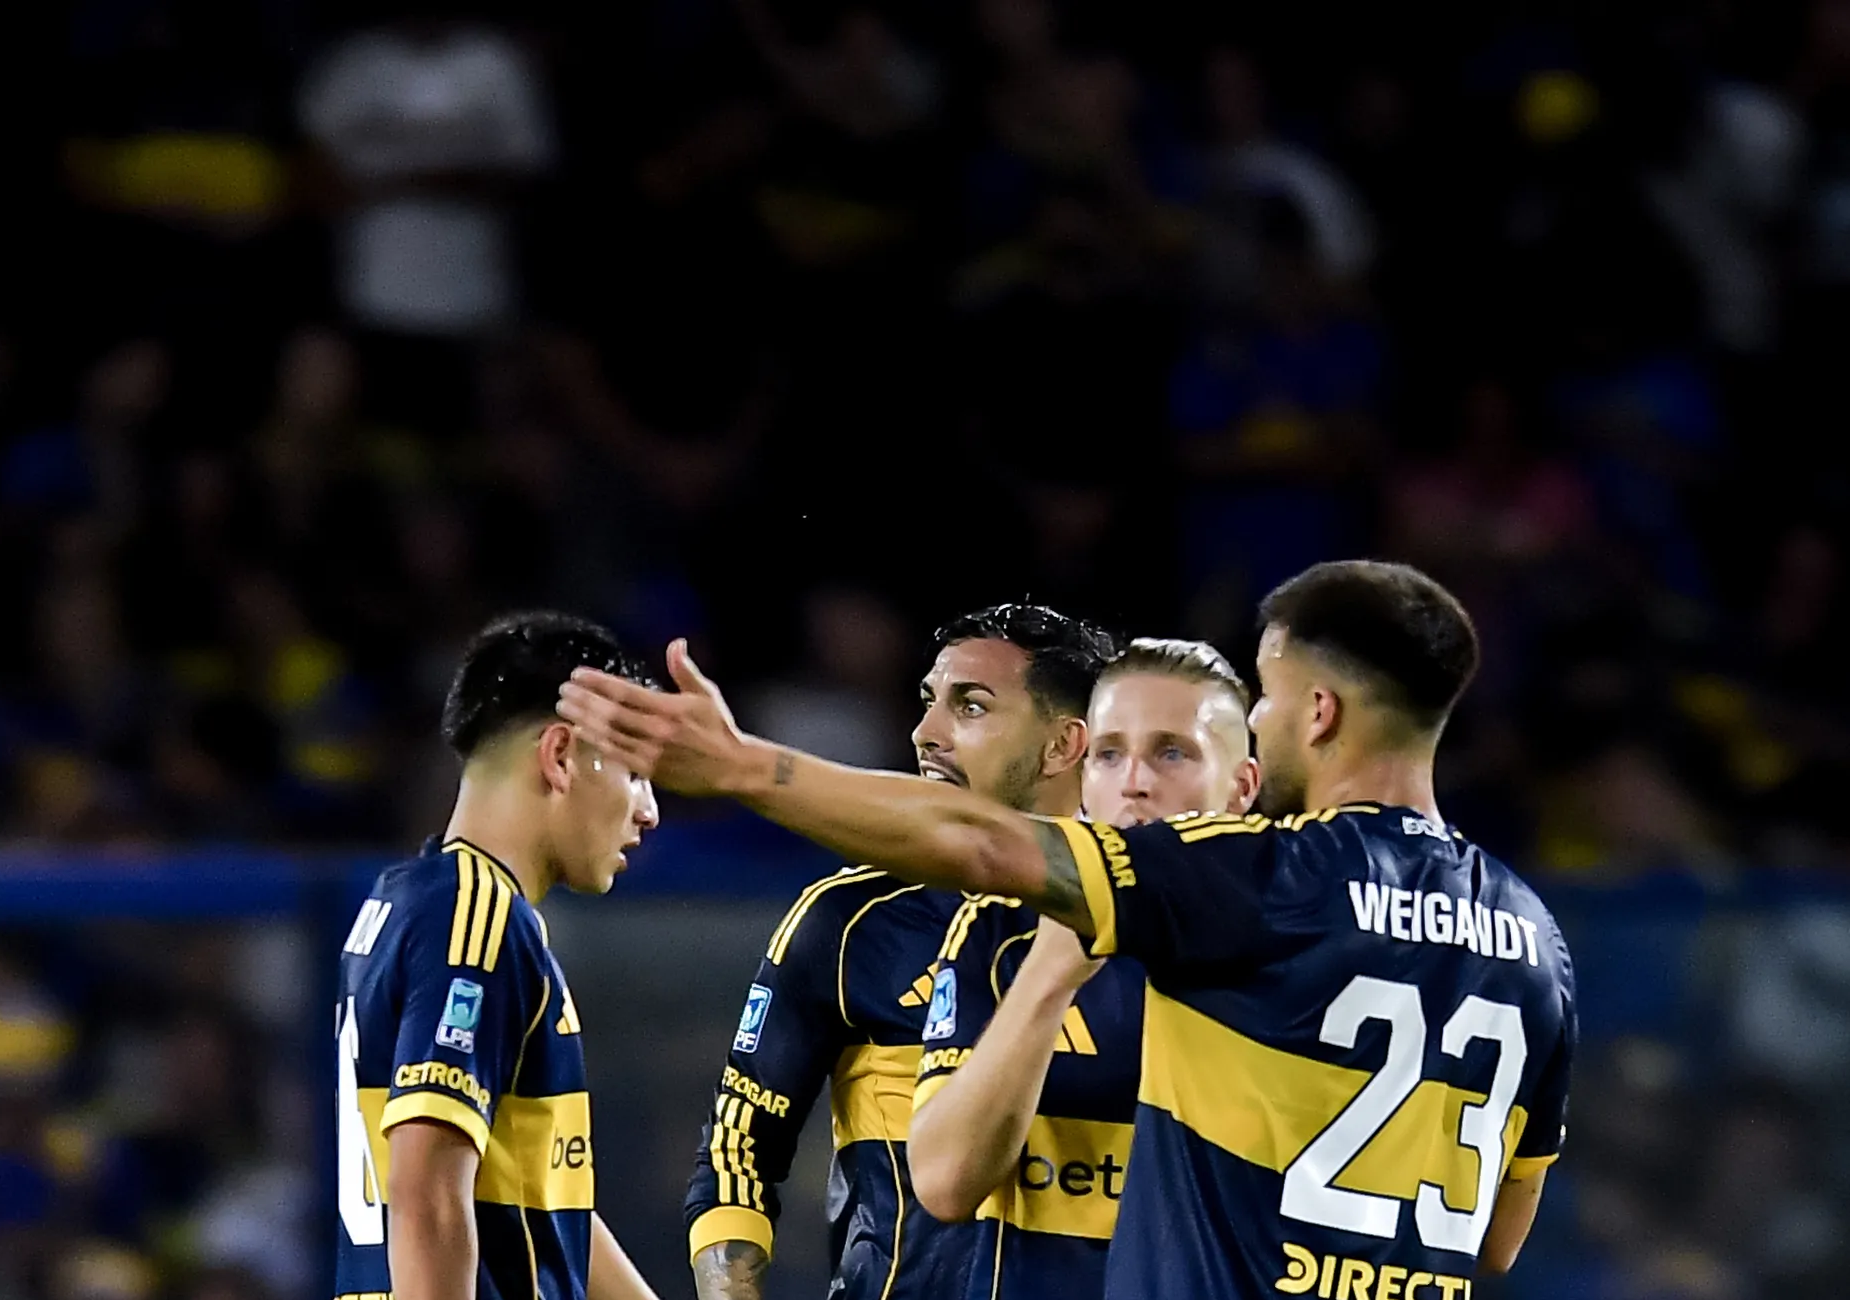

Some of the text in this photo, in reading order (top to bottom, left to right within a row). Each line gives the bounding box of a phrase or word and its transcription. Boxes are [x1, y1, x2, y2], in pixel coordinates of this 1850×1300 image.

[1348, 880, 1539, 967] WEIGANDT
[734, 1029, 756, 1049] PF
[1280, 974, 1528, 1257] 23
[1017, 1148, 1123, 1201] bet
